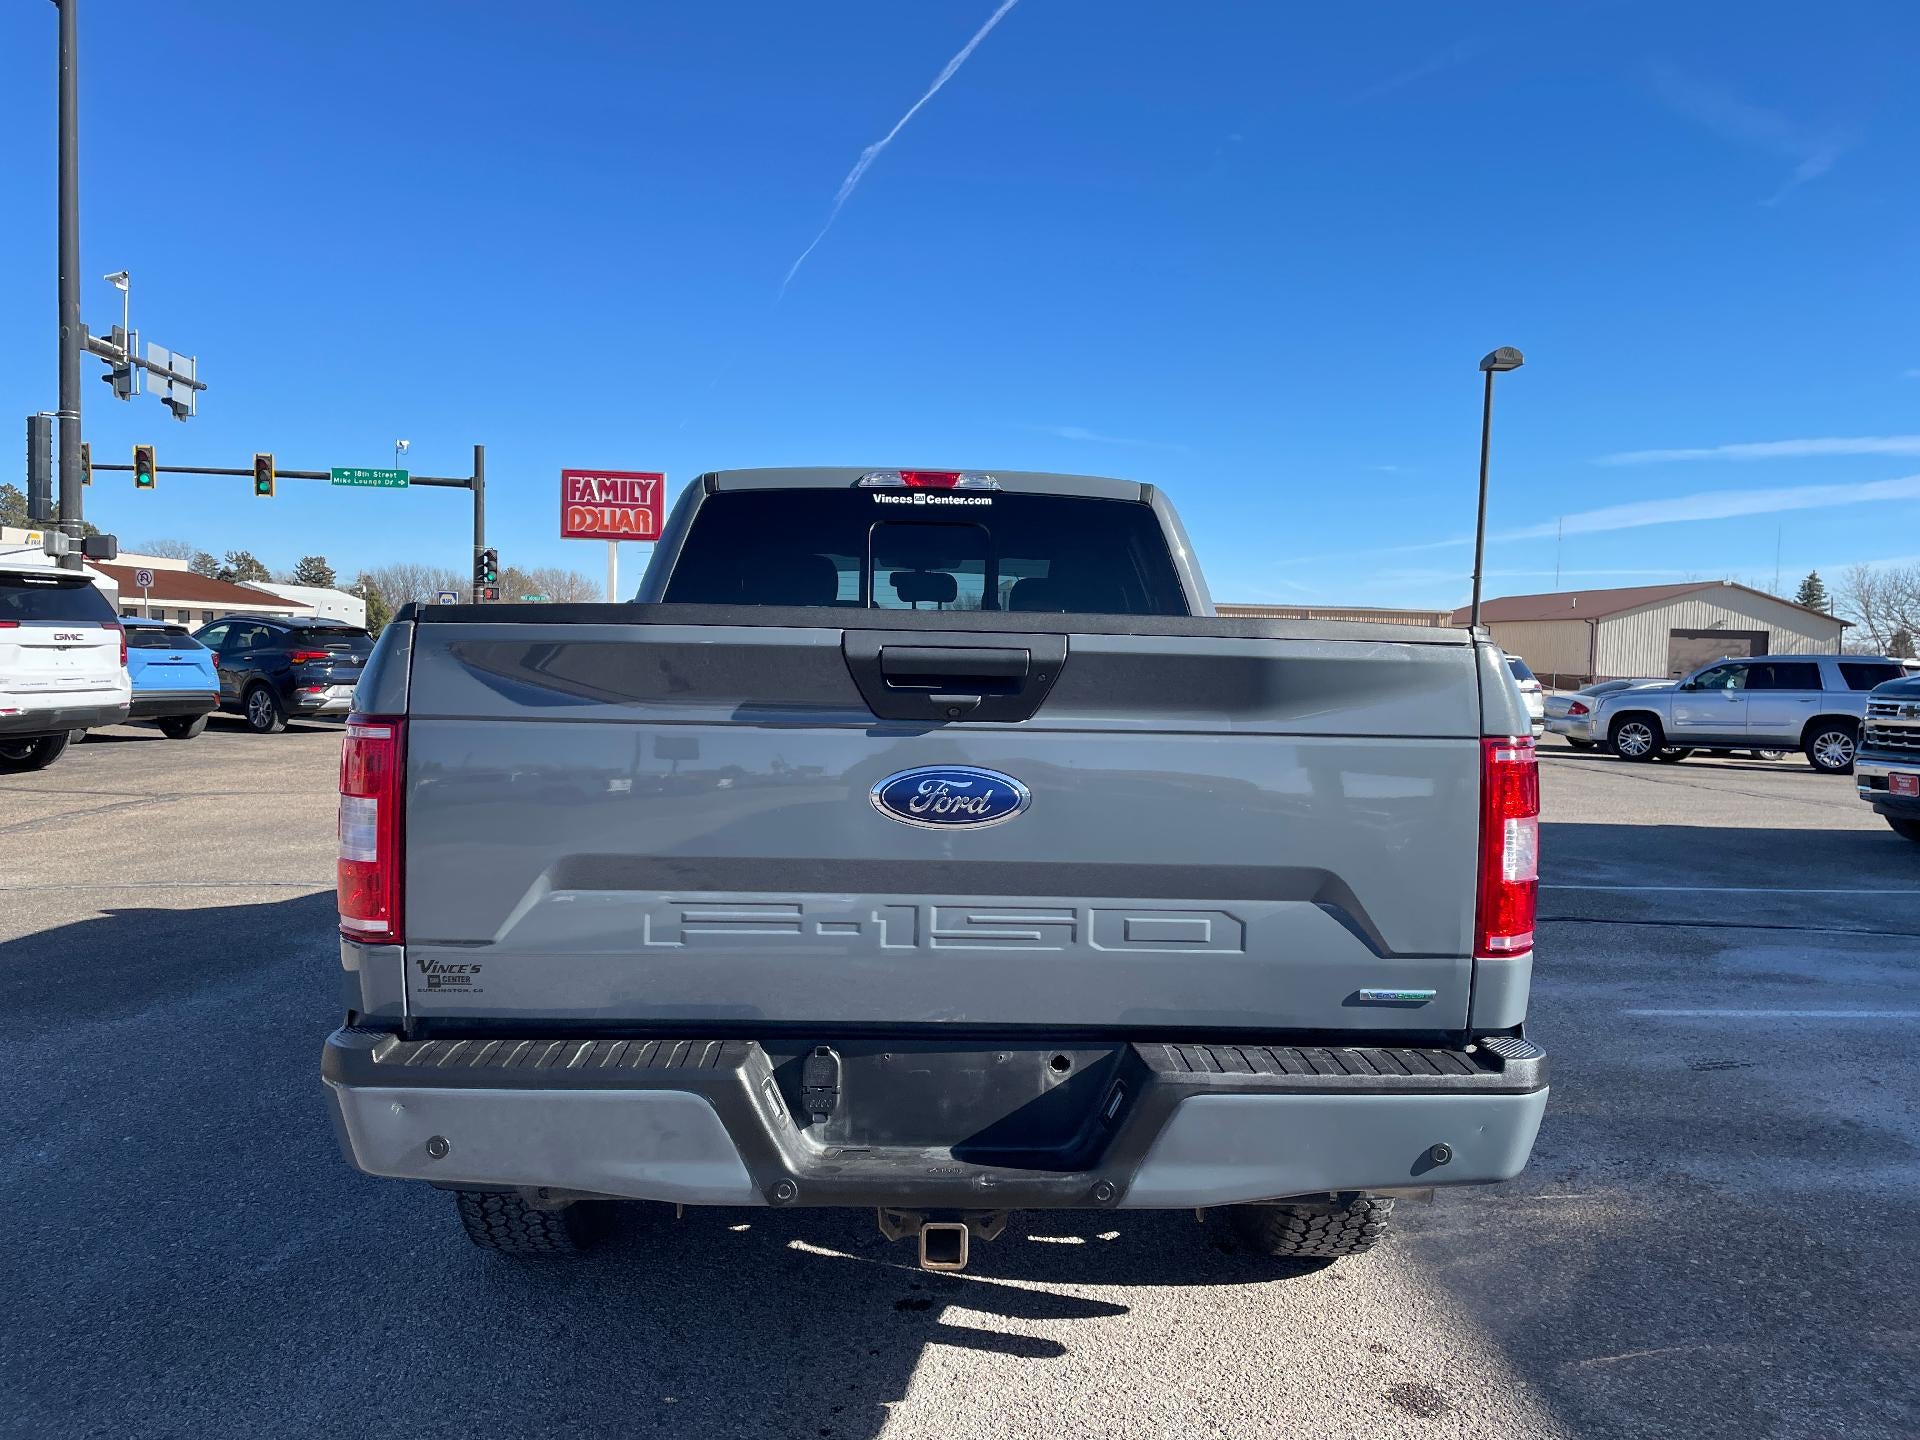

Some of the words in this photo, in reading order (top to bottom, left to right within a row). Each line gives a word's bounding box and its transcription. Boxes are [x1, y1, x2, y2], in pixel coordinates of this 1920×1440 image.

[354, 478, 382, 486] Lounge
[373, 471, 397, 479] Street
[568, 477, 656, 505] FAMILY
[567, 505, 653, 534] DOLLAR
[54, 633, 84, 641] GMC
[909, 778, 994, 818] Ford
[643, 901, 1248, 954] F-150
[442, 975, 471, 983] CENTER
